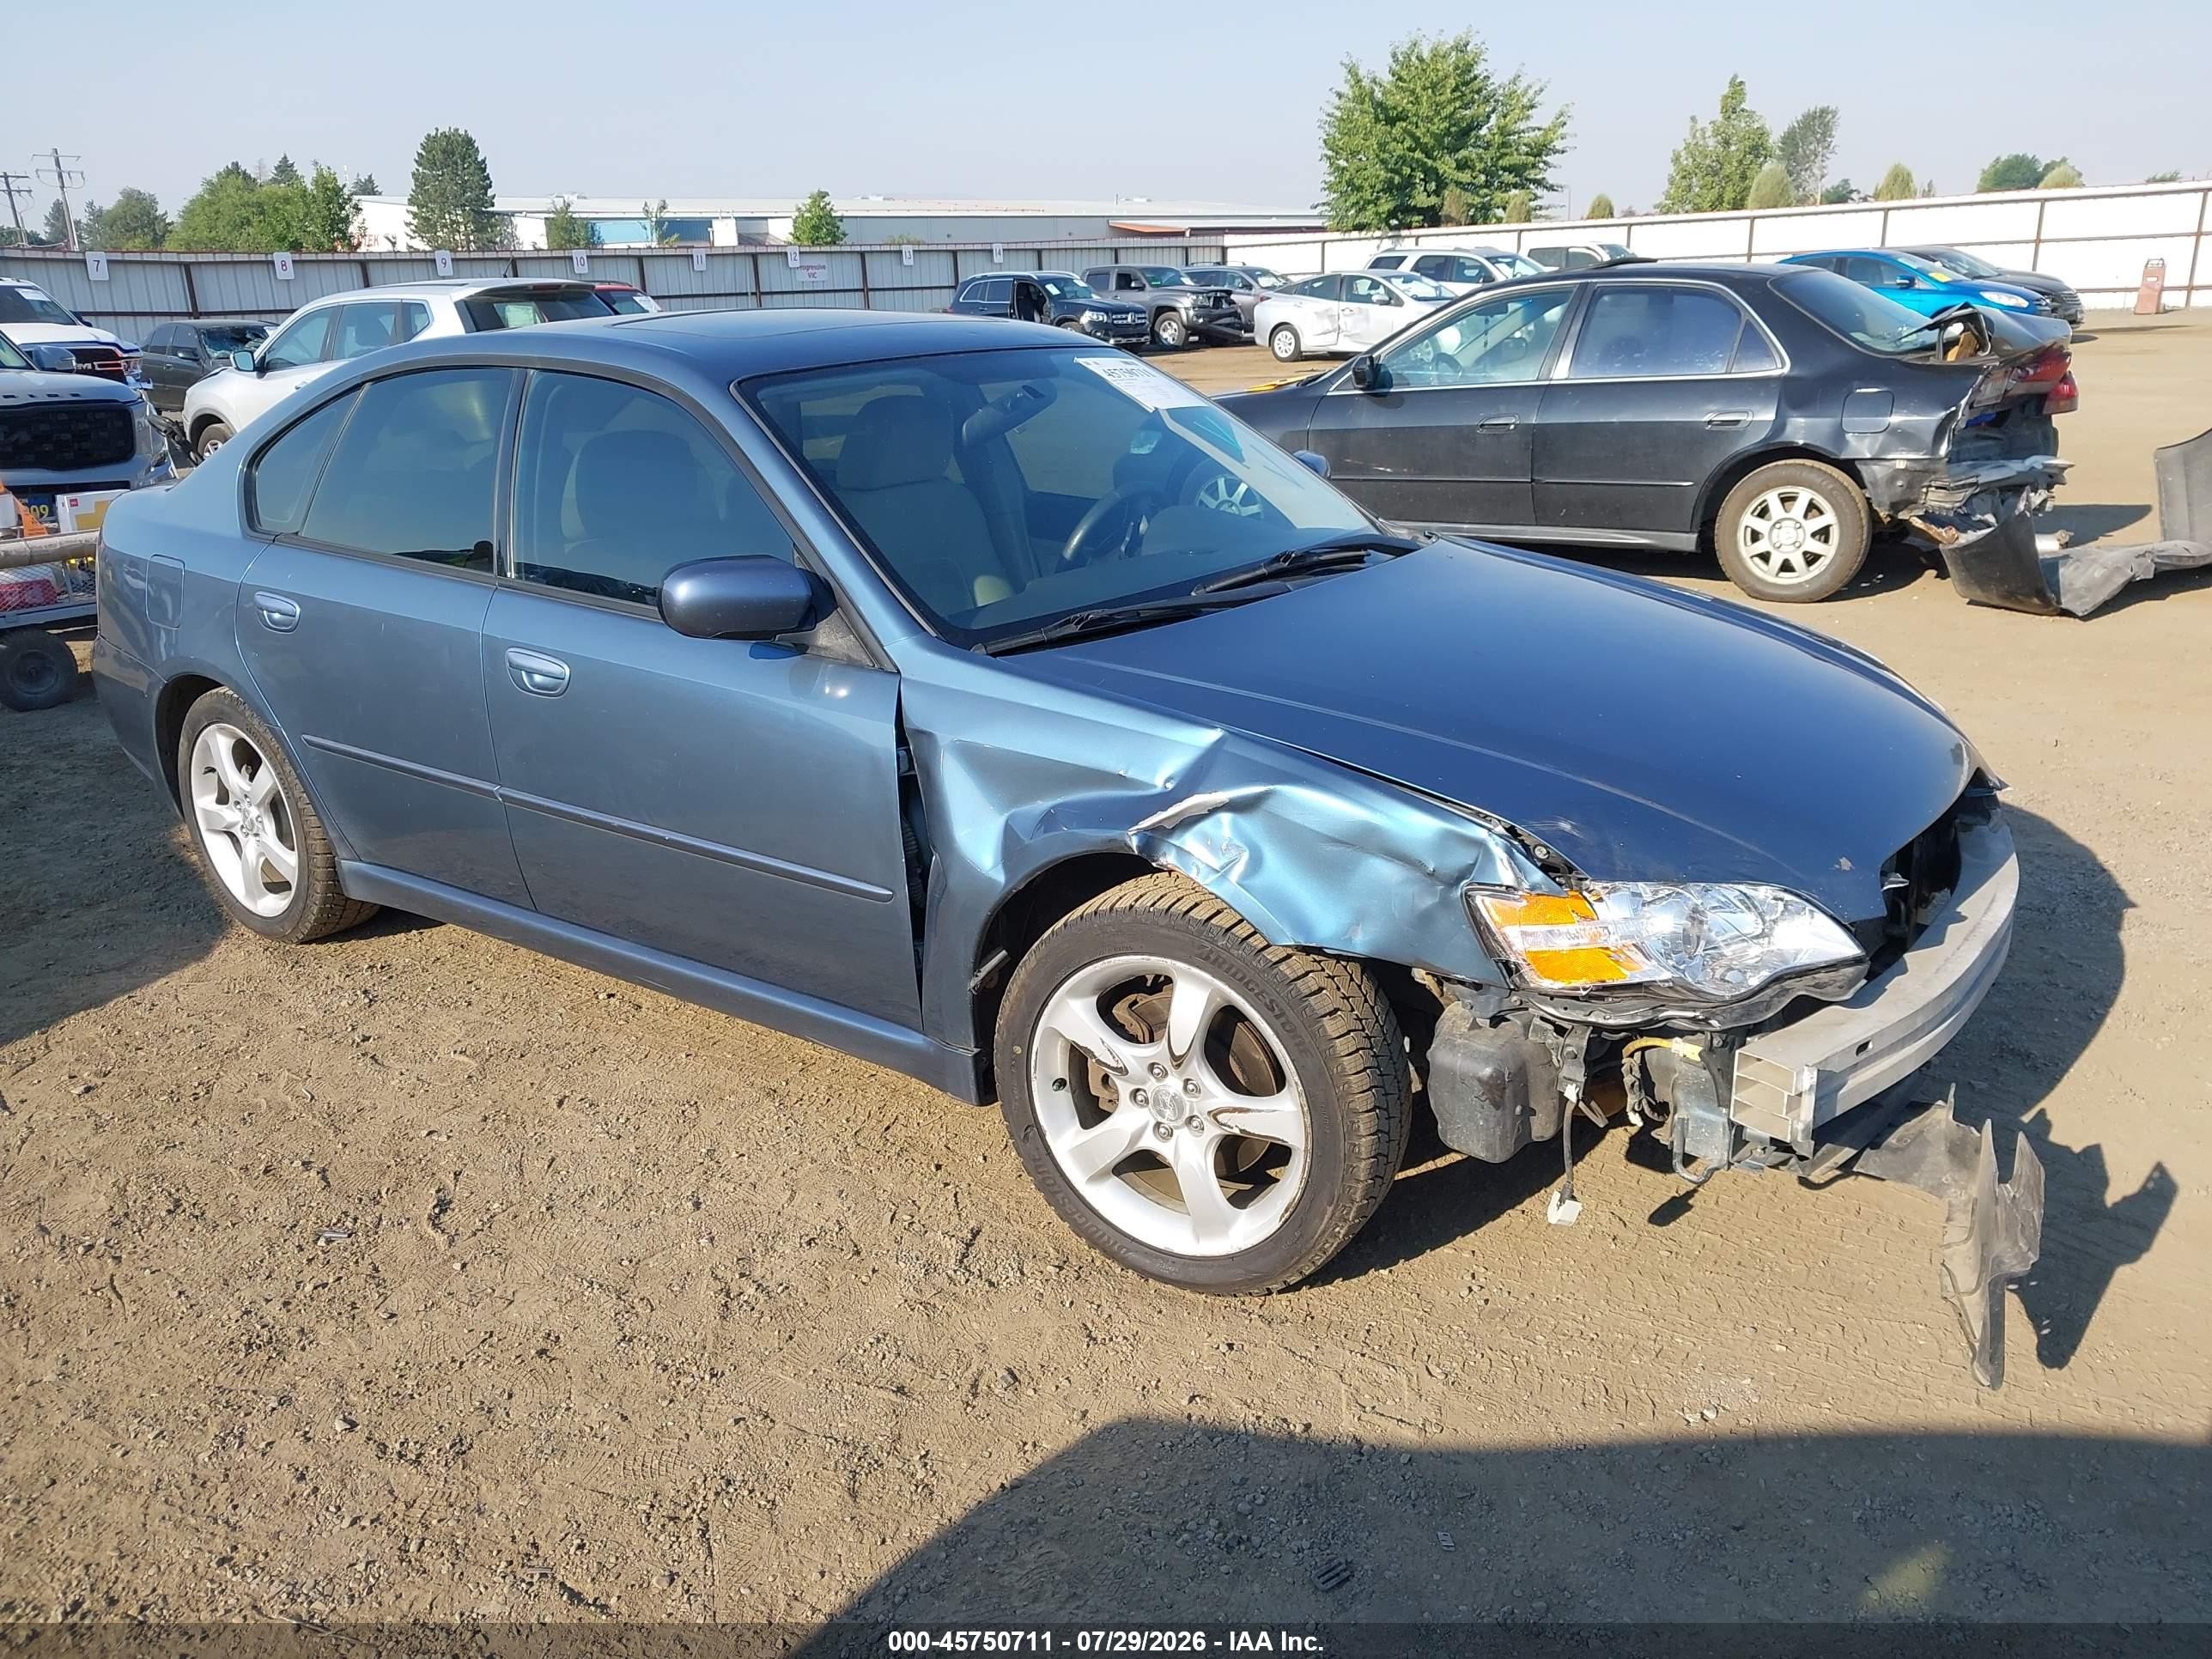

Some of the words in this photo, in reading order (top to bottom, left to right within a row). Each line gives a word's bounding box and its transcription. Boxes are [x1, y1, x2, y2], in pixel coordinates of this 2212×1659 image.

[789, 252, 798, 262] 12
[904, 250, 912, 260] 13
[994, 247, 1002, 258] 14
[441, 257, 447, 269] 9
[575, 256, 586, 267] 10
[696, 253, 703, 265] 11
[92, 259, 100, 273] 7
[280, 259, 288, 272] 8
